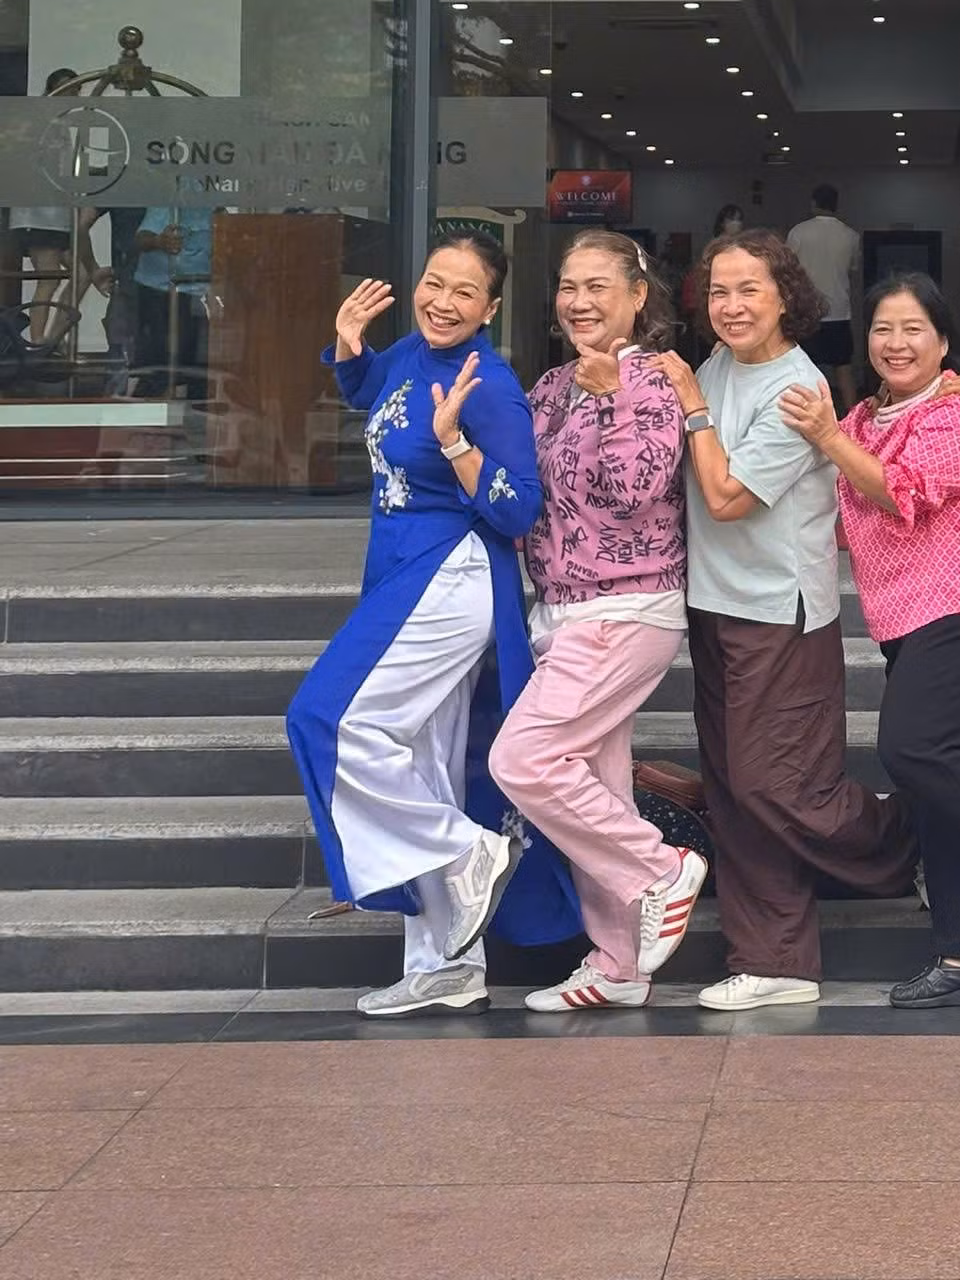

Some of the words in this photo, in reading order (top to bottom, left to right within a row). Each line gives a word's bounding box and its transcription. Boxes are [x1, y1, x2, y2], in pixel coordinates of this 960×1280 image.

[554, 191, 616, 201] WELCOME
[595, 521, 622, 564] DKNY
[617, 538, 635, 565] NEW
